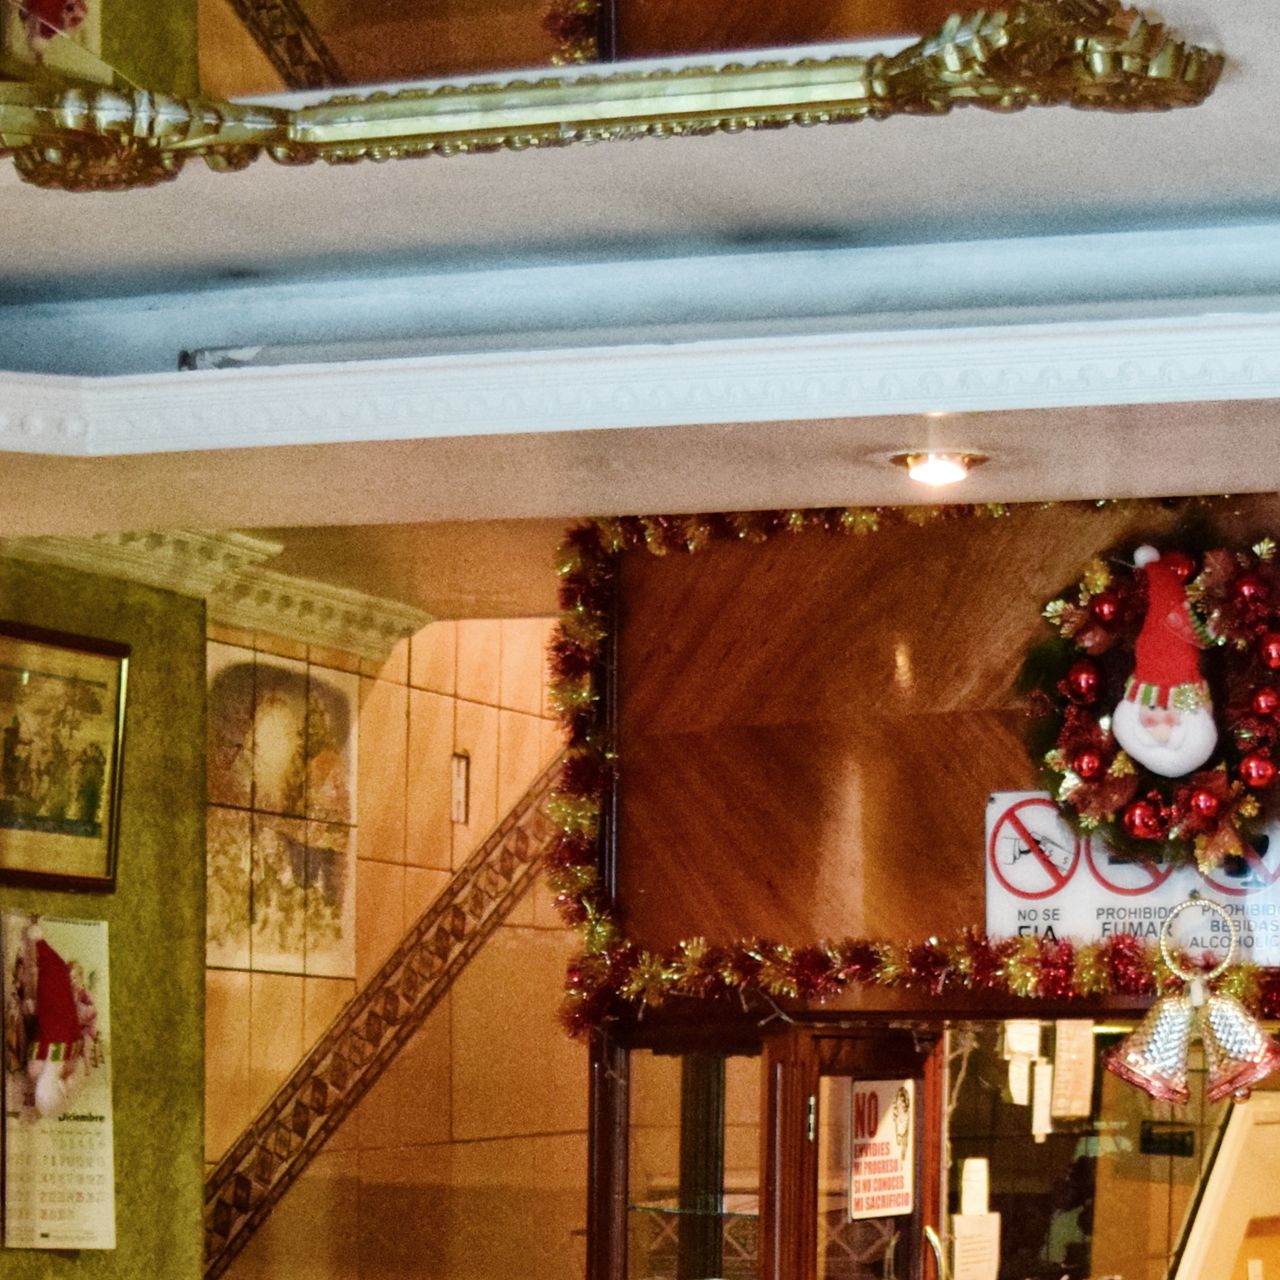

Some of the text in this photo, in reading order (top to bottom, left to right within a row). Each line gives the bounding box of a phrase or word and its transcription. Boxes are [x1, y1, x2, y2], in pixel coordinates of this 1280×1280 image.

[1017, 908, 1060, 921] NO SE
[1096, 906, 1180, 920] PROHIBIDO
[1101, 921, 1173, 938] FUMAR
[1210, 919, 1280, 933] BEBIDAS
[854, 1090, 879, 1139] NO
[865, 1192, 910, 1211] SACRIFICIO
